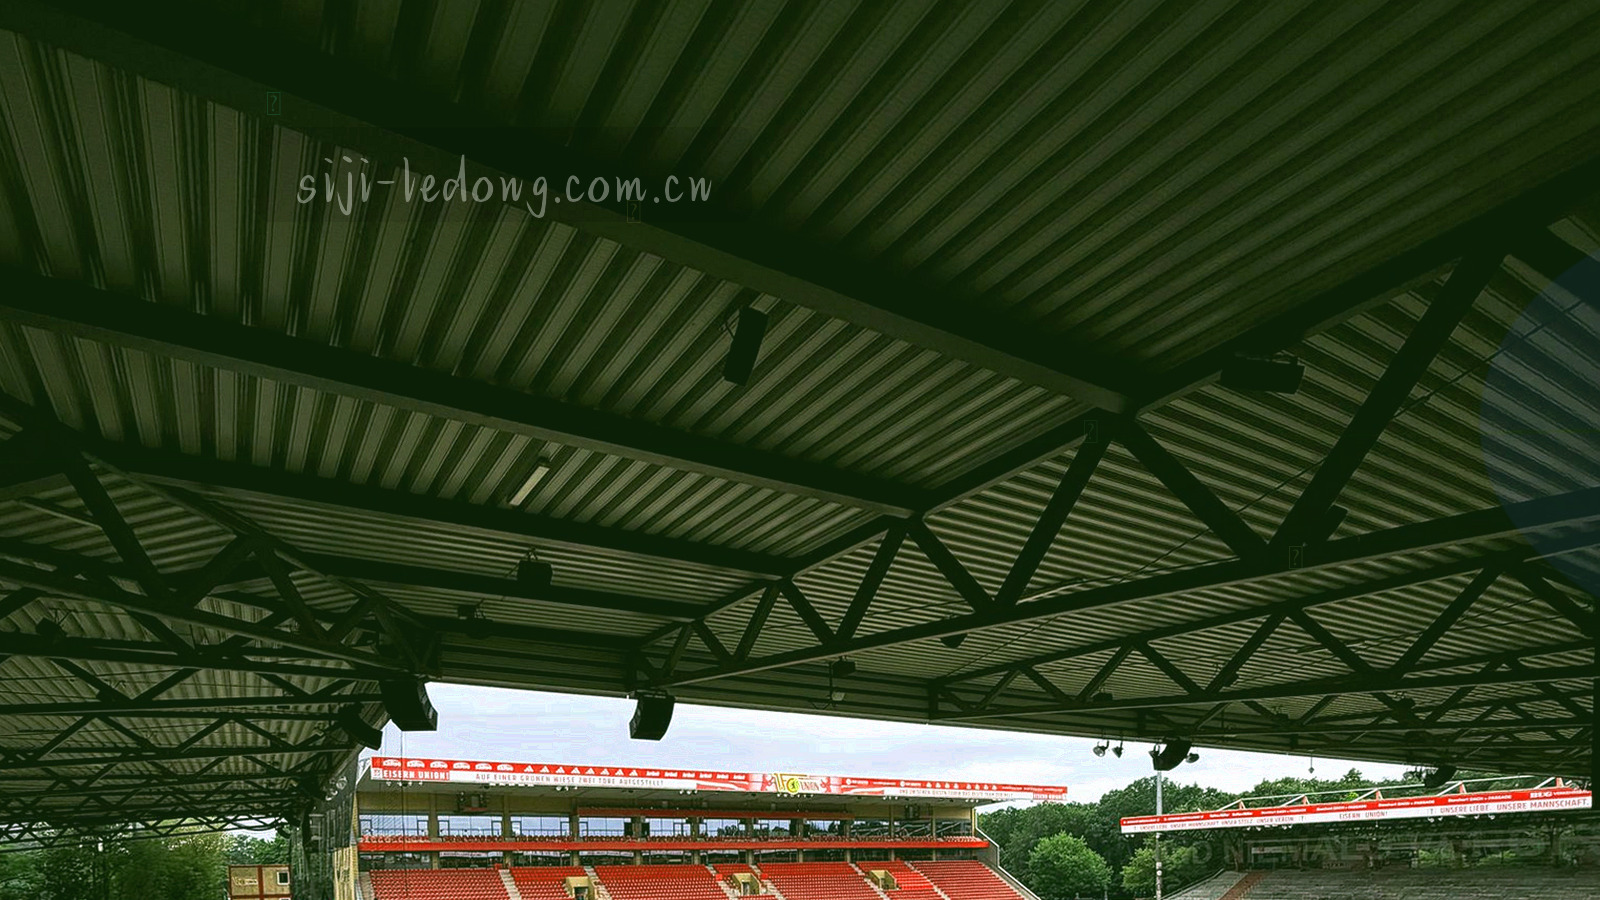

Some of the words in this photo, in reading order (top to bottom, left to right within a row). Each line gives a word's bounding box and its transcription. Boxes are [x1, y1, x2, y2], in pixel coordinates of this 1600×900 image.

[383, 769, 415, 779] EISERN
[418, 770, 449, 780] UNION!
[1440, 804, 1467, 813] UNSERE
[1497, 802, 1527, 810] UNSERE
[1530, 798, 1590, 809] MANNSCHAFT.
